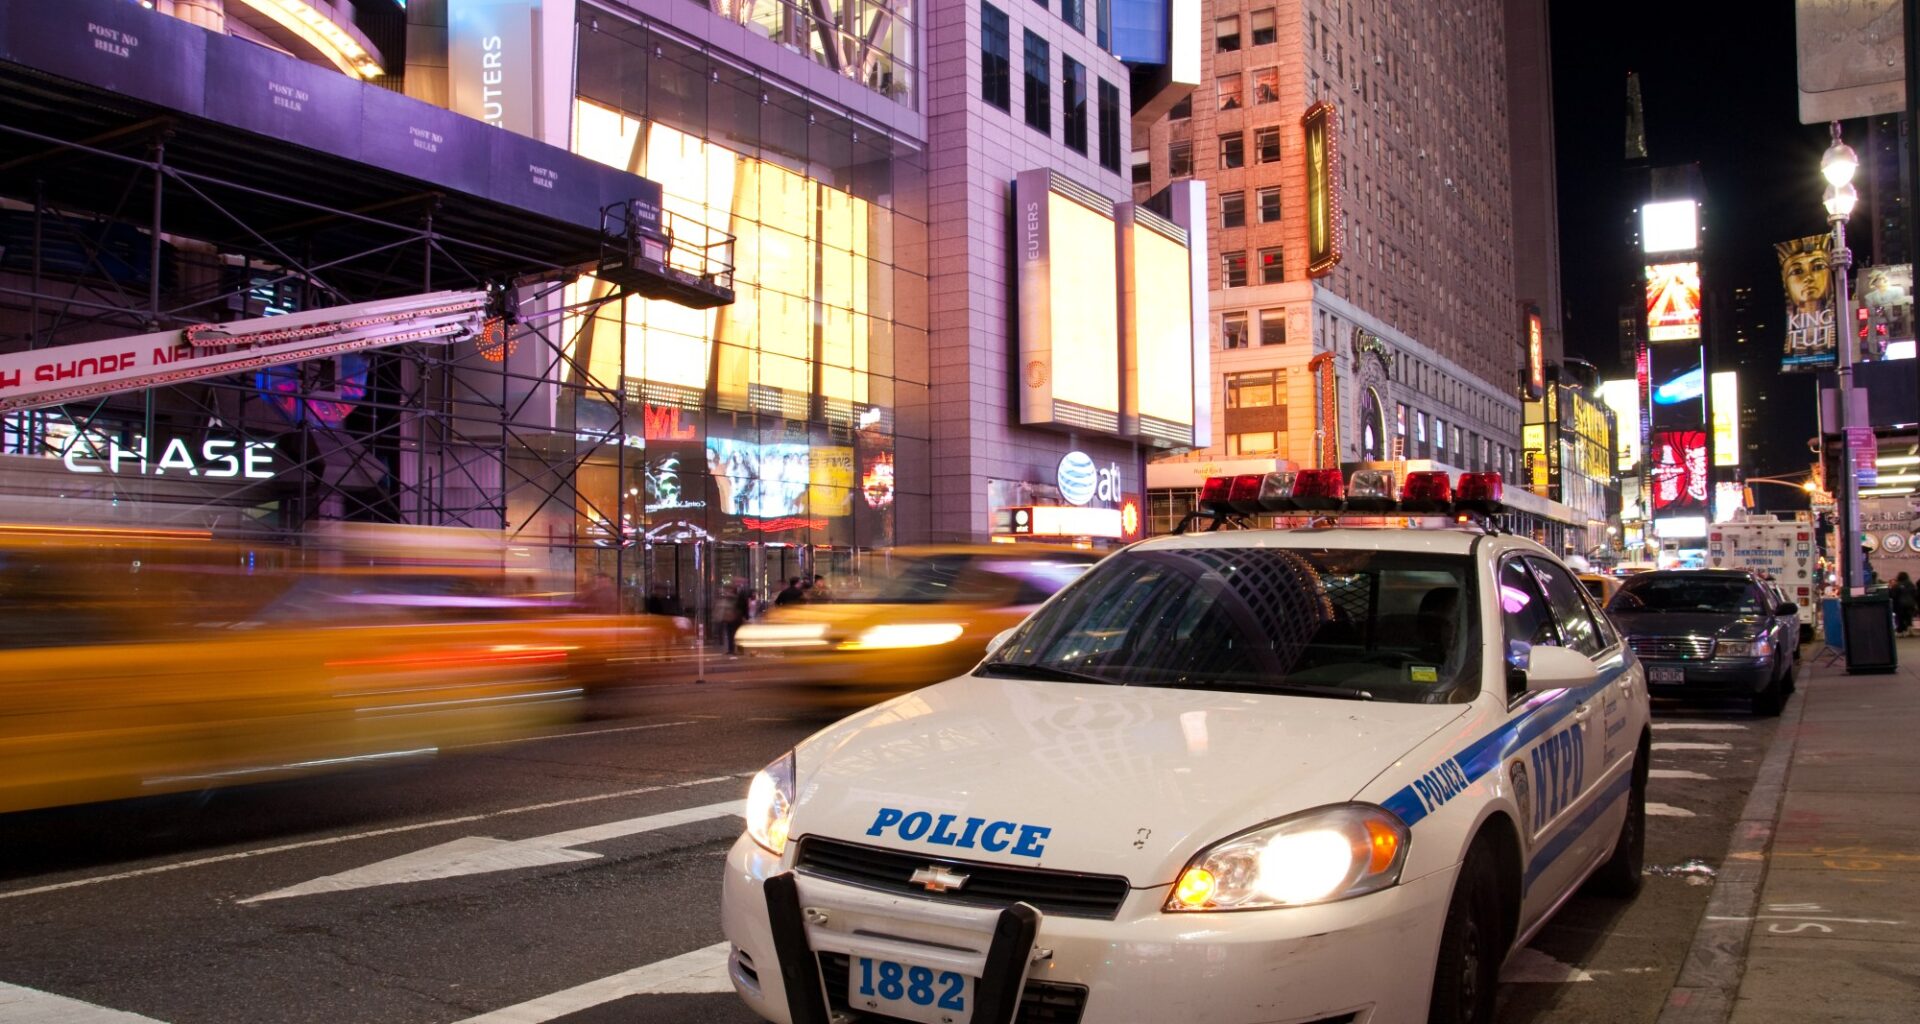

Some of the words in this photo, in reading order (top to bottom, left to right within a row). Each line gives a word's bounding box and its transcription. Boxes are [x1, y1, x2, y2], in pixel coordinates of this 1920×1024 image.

[88, 23, 119, 41] POST
[121, 31, 138, 47] NO
[94, 39, 129, 58] BILLS
[269, 81, 294, 98] POST
[295, 89, 309, 102] NO
[482, 35, 502, 128] UTERS
[273, 96, 301, 111] BILLS
[409, 127, 429, 141] POST
[431, 132, 443, 144] NO
[413, 139, 437, 153] BILLS
[529, 164, 547, 177] POST
[548, 169, 558, 181] NO
[532, 176, 553, 189] BILLS
[1788, 309, 1833, 331] KING
[1788, 324, 1833, 348] TUT
[62, 432, 276, 478] CHASE
[1412, 756, 1469, 814] POLICE
[1531, 723, 1584, 833] NYPD
[866, 808, 1052, 858] POLICE
[859, 957, 965, 1012] 1882
